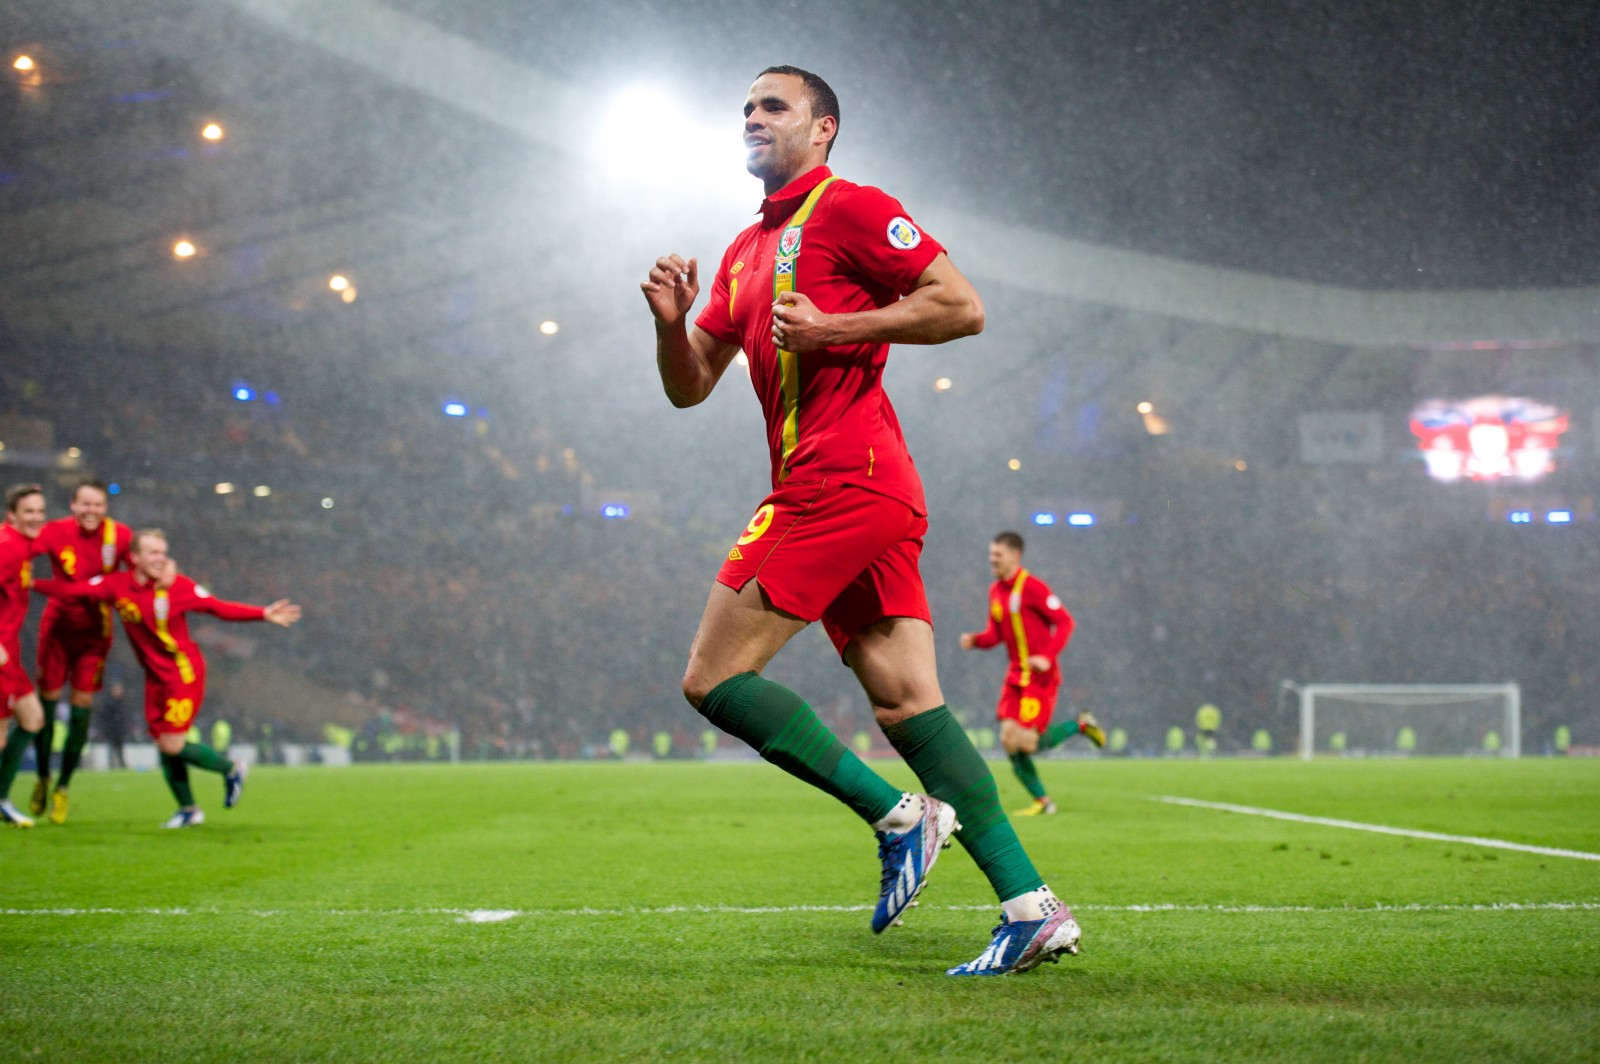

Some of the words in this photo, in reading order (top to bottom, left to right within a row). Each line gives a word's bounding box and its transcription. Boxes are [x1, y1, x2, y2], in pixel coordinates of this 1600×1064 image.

[737, 503, 775, 546] 9
[60, 550, 76, 575] 2
[164, 697, 194, 722] 20
